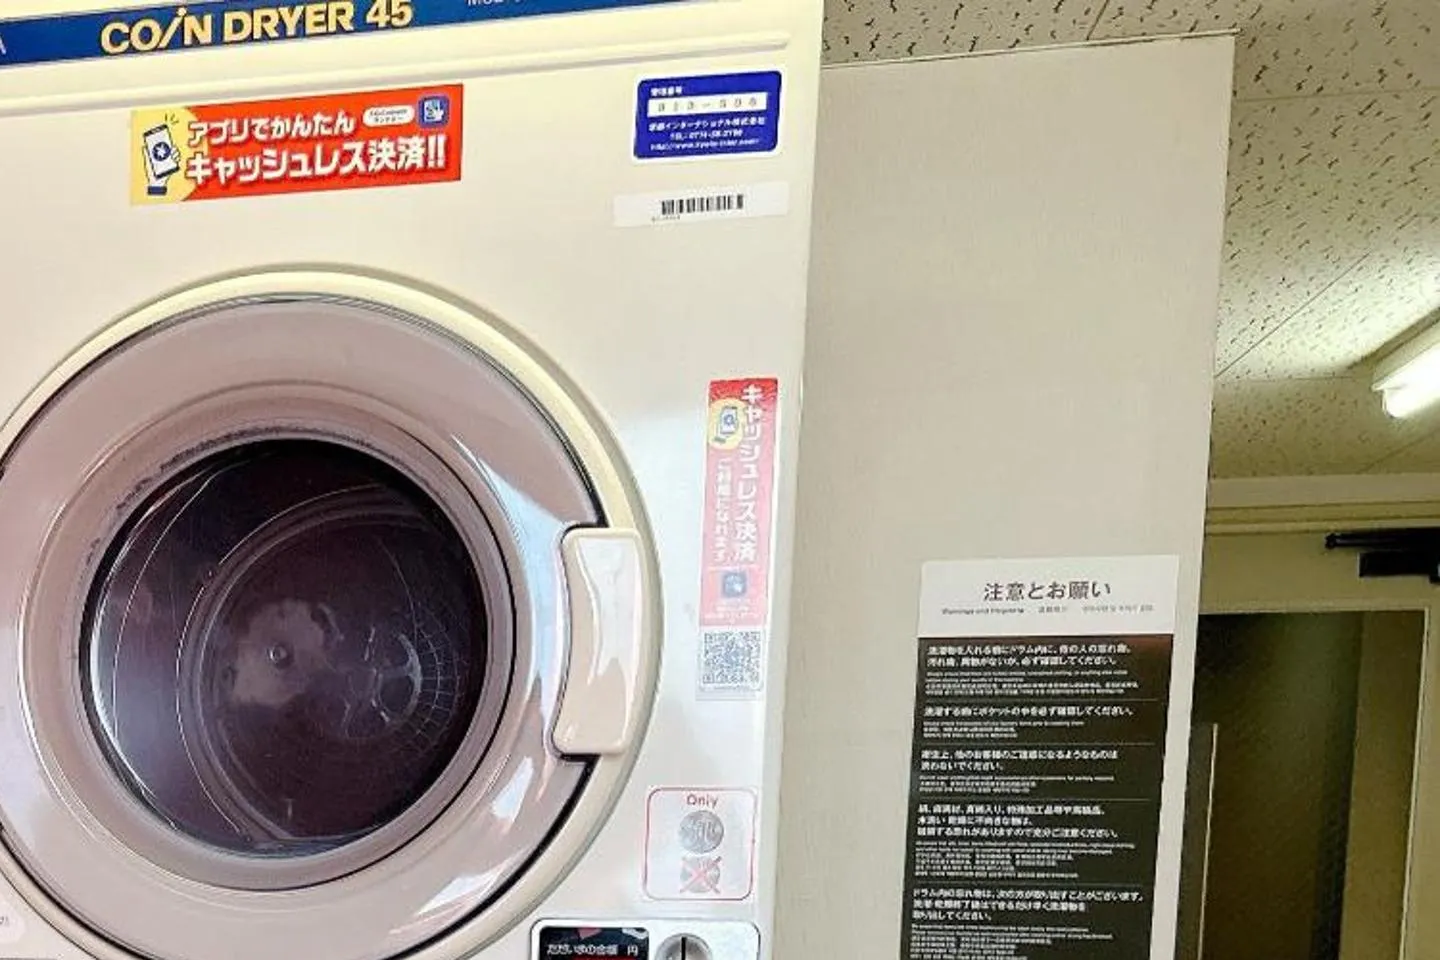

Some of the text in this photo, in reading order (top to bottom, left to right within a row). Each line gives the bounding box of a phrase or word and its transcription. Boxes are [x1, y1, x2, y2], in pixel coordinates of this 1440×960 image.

[223, 2, 354, 43] DRYER
[365, 0, 412, 27] 45
[187, 112, 357, 144] アプリでかんたん
[186, 137, 447, 185] キャッシュレス決済!!
[734, 382, 767, 563] キャッシュレス決済
[983, 580, 1112, 602] 注意とお願い
[686, 793, 718, 808] Only
